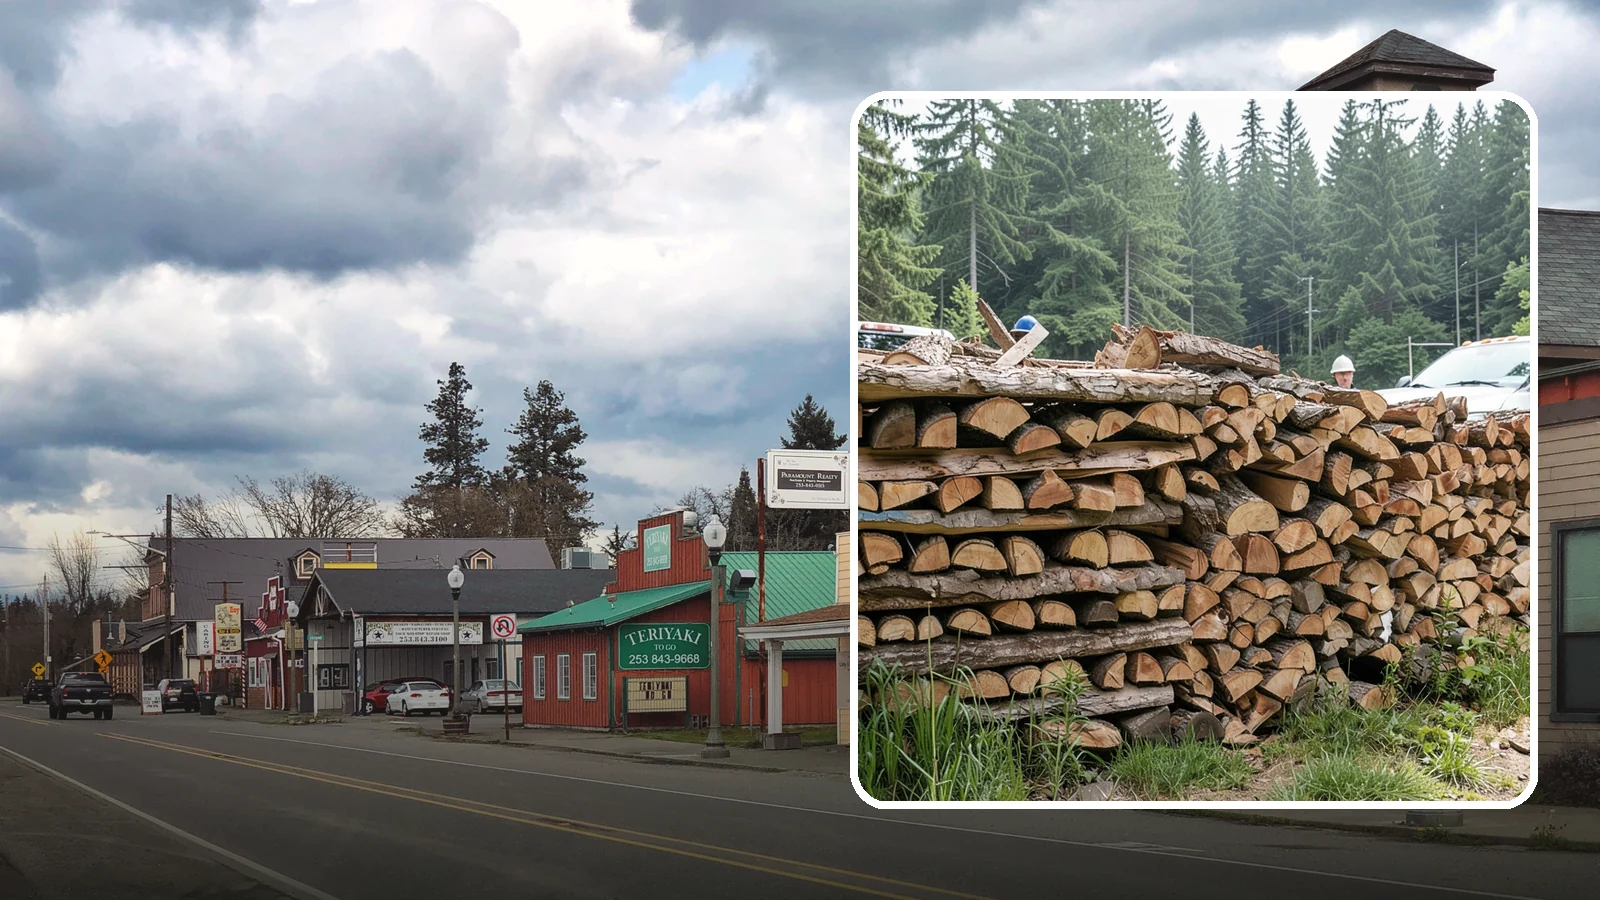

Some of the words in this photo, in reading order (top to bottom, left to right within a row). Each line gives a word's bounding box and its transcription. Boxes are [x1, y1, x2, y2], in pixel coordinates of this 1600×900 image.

[781, 471, 815, 479] PARAMOUNT
[817, 472, 839, 480] REALTY
[624, 627, 702, 646] TERIYAKI
[628, 654, 649, 665] 253
[651, 653, 700, 664] 843-9668
